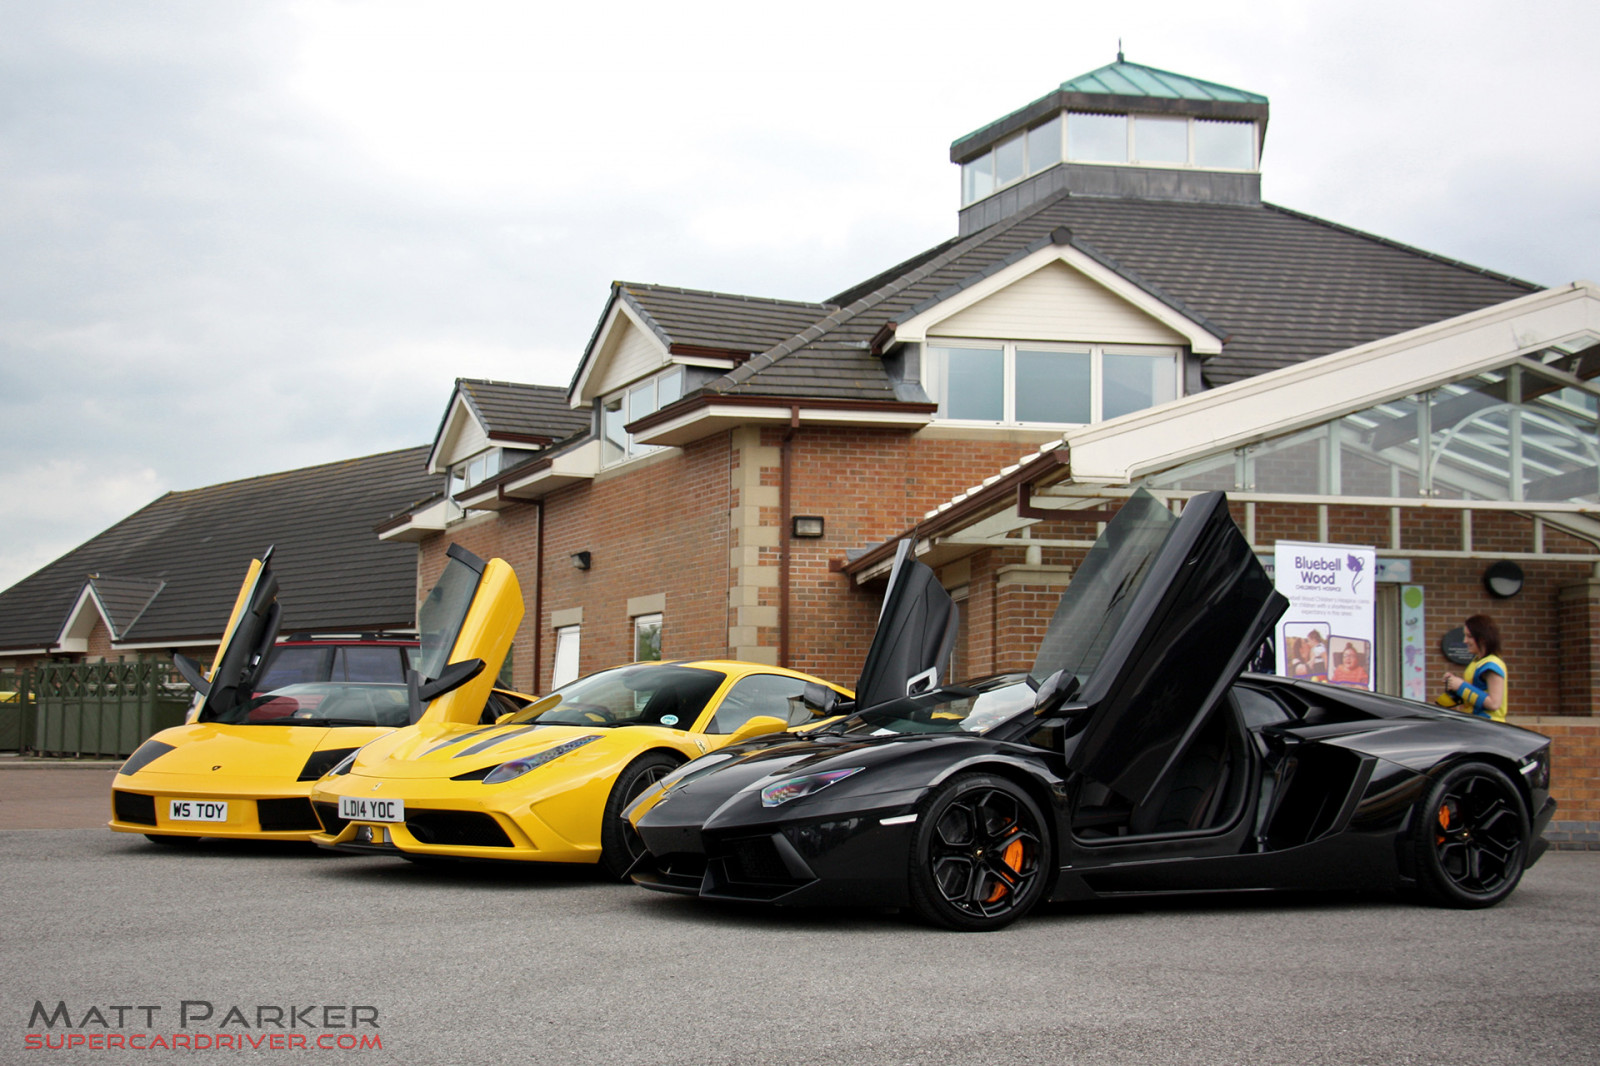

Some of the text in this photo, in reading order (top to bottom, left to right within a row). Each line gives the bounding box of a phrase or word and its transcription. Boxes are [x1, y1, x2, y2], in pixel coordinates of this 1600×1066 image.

[1294, 556, 1342, 571] Bluebell
[1300, 571, 1336, 585] Wood
[196, 803, 225, 818] TOY
[343, 799, 395, 818] LD14 YOC
